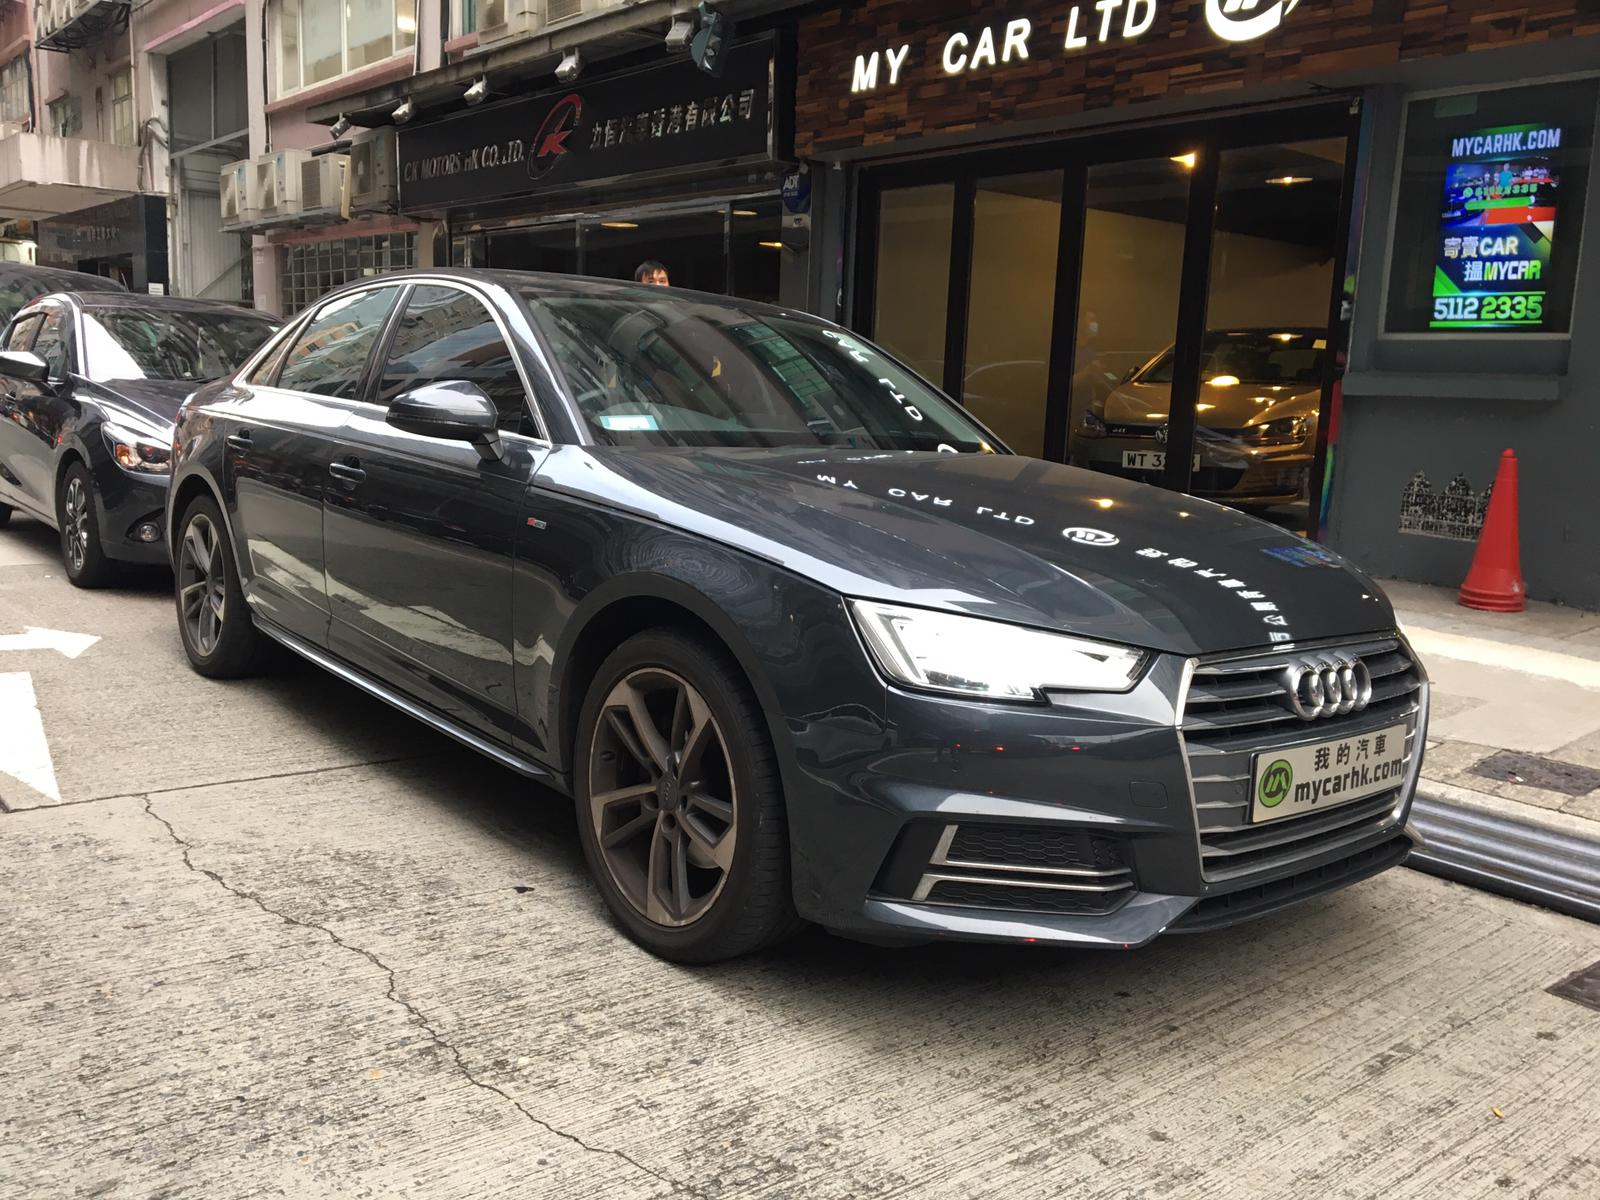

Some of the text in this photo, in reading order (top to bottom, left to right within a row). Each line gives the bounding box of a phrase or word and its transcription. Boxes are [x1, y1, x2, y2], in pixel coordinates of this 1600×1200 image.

[852, 0, 1157, 92] MY CAR LTD
[1451, 127, 1561, 158] MYCARHK.COM
[1433, 296, 1543, 319] 5112 2335
[1127, 453, 1147, 467] WT
[1314, 734, 1387, 771] 我的汽車
[1294, 757, 1403, 804] mycarhk.com
